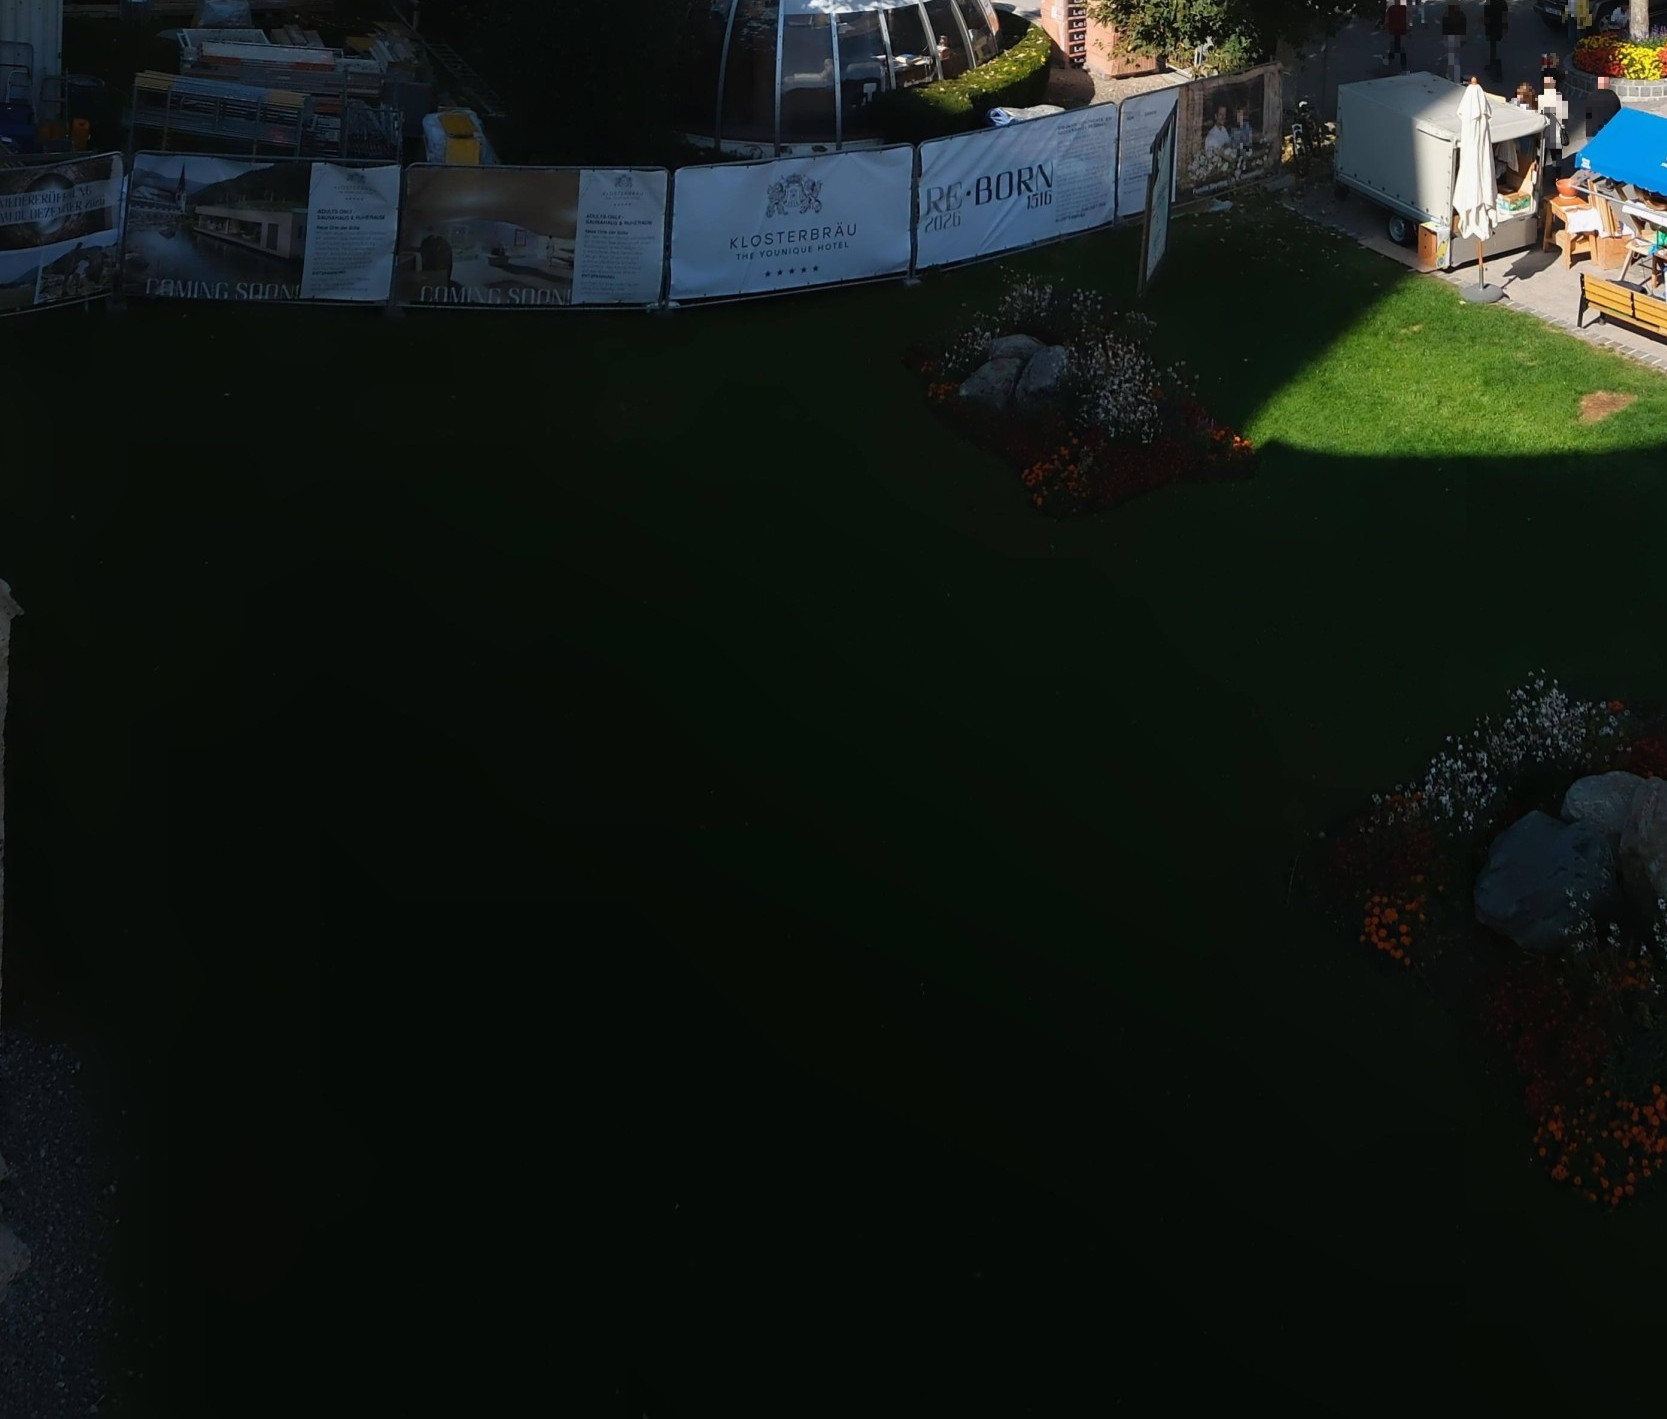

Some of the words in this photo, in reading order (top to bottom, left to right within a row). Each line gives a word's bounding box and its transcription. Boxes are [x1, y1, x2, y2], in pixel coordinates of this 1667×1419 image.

[1026, 190, 1052, 211] 1516
[924, 212, 961, 233] 2026
[729, 222, 857, 250] KLOSTERBRÄU
[736, 252, 754, 261] THE
[760, 246, 813, 259] YOUNIQUE
[817, 241, 849, 252] HOTEL
